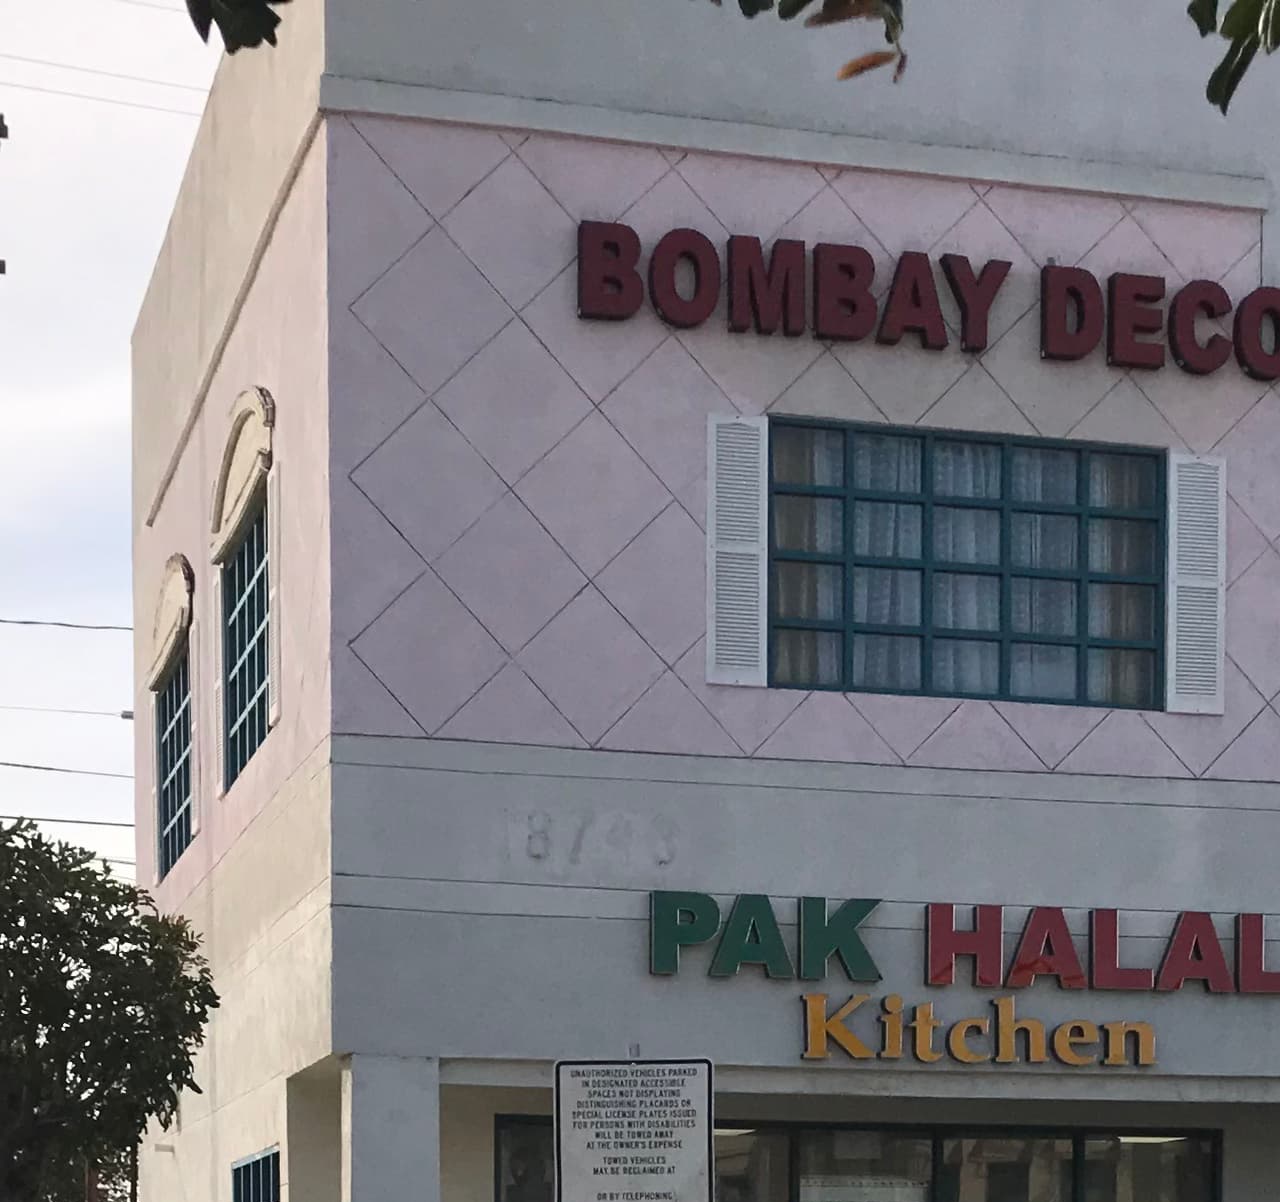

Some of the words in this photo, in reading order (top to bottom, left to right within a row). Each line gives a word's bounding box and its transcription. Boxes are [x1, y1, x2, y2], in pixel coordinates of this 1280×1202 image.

[577, 219, 1013, 353] BOMBAY
[649, 890, 883, 982] PAK
[801, 993, 1158, 1067] Kitchen
[570, 1069, 628, 1078] UNAUTHORIZED
[630, 1069, 666, 1077] VEHICLES
[668, 1068, 697, 1077] PARKED
[582, 1079, 590, 1087] IN
[591, 1079, 638, 1087] DESIGNATED
[640, 1078, 686, 1087] ACCESSIBLE
[587, 1089, 616, 1098] SPACES
[619, 1089, 634, 1098] NOT
[635, 1089, 681, 1098] DISPLAYING
[576, 1100, 637, 1108] DISTINGUISHING
[639, 1099, 679, 1108] PLACARDS
[680, 1099, 691, 1107] OR
[572, 1110, 603, 1119] SPECIAL
[605, 1110, 635, 1118] LICENSE
[638, 1109, 668, 1118] PLATES
[669, 1109, 697, 1118] ISSUED
[572, 1120, 588, 1129] FOR
[590, 1120, 625, 1129] PERSONS
[627, 1120, 646, 1128] WITH
[647, 1120, 696, 1128] DISABILITIES
[594, 1130, 612, 1139] WILL
[614, 1130, 625, 1139] BE
[627, 1130, 652, 1139] TOWED
[653, 1130, 673, 1138] AWAY
[586, 1141, 596, 1150] AT
[597, 1141, 612, 1150] THE
[613, 1140, 647, 1149] OWNER'S
[648, 1140, 683, 1149] EXPENSE
[603, 1156, 628, 1165] TOWED
[630, 1156, 666, 1165] VEHICLES
[593, 1167, 610, 1175] MAY
[611, 1167, 620, 1175] BE
[623, 1166, 665, 1175] RECLAIMED
[666, 1166, 676, 1174] AT
[596, 1193, 608, 1201] OR
[609, 1192, 620, 1200] BY
[621, 1191, 673, 1200] TELEPHONING
